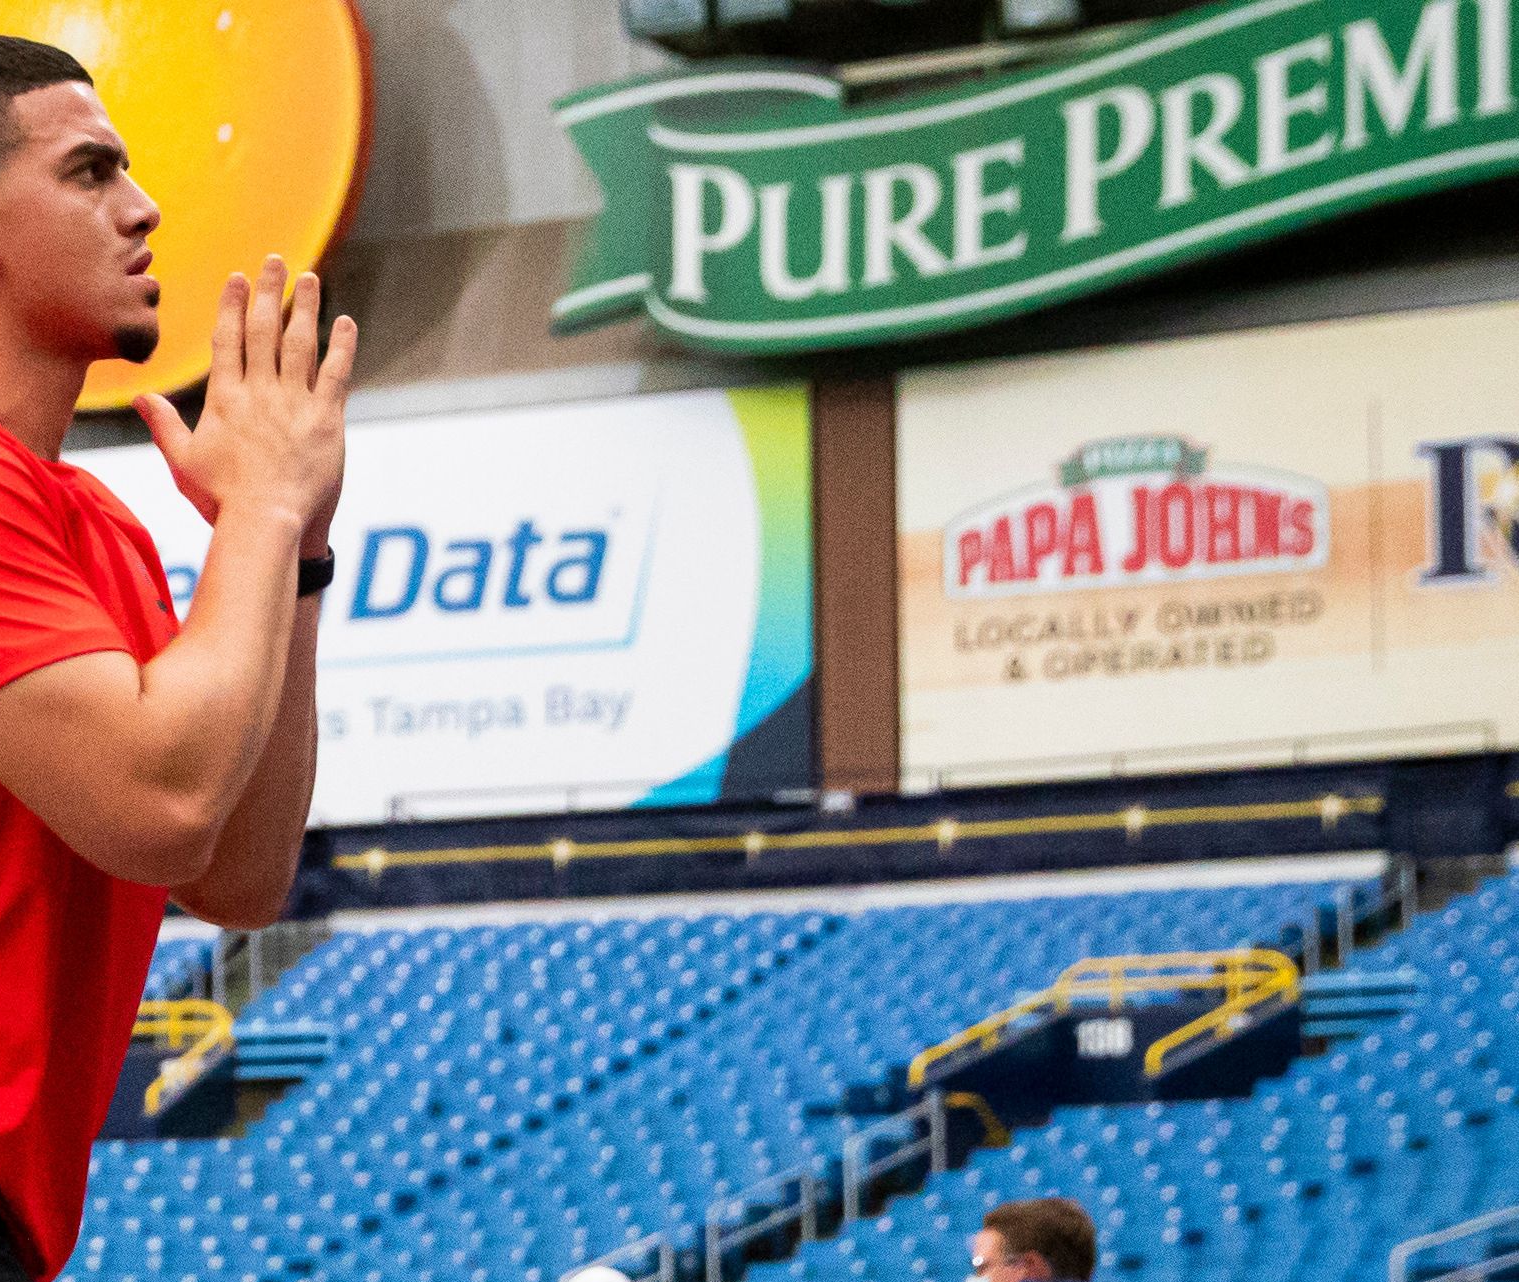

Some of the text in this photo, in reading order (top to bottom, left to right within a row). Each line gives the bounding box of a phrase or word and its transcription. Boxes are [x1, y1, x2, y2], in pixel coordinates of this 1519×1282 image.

[668, 138, 1029, 304] PURE
[346, 517, 613, 624] Data
[957, 494, 1104, 588] PAPA
[953, 589, 1324, 654] LOCALLY OWNED
[1041, 630, 1277, 680] OPERATED
[369, 694, 527, 740] Tampa
[544, 684, 633, 734] Bay
